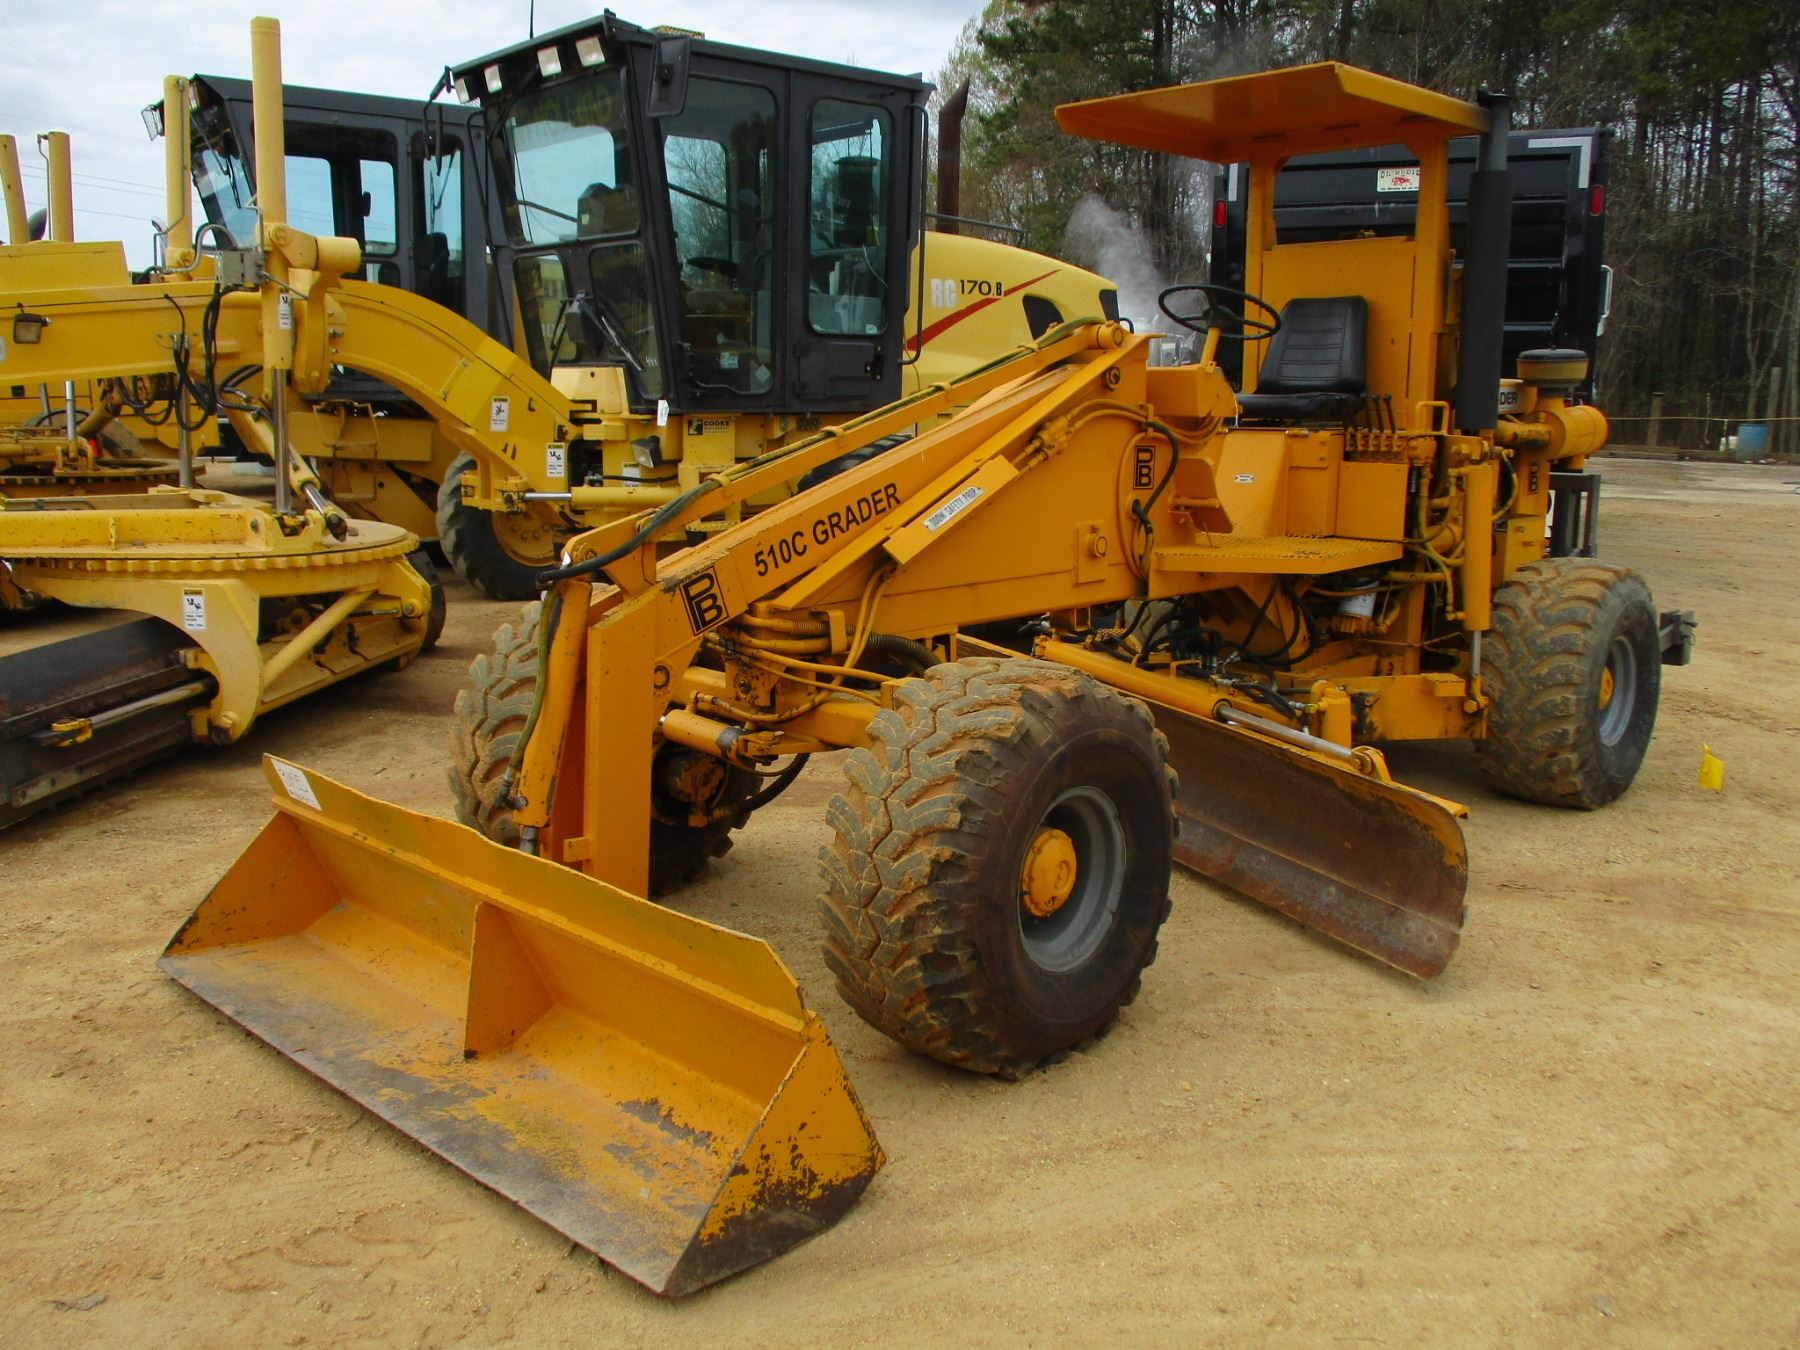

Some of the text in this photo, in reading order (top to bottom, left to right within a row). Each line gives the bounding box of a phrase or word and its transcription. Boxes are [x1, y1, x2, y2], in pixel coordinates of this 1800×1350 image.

[960, 279, 1002, 297] 170.B
[754, 482, 901, 577] 510C GRADER
